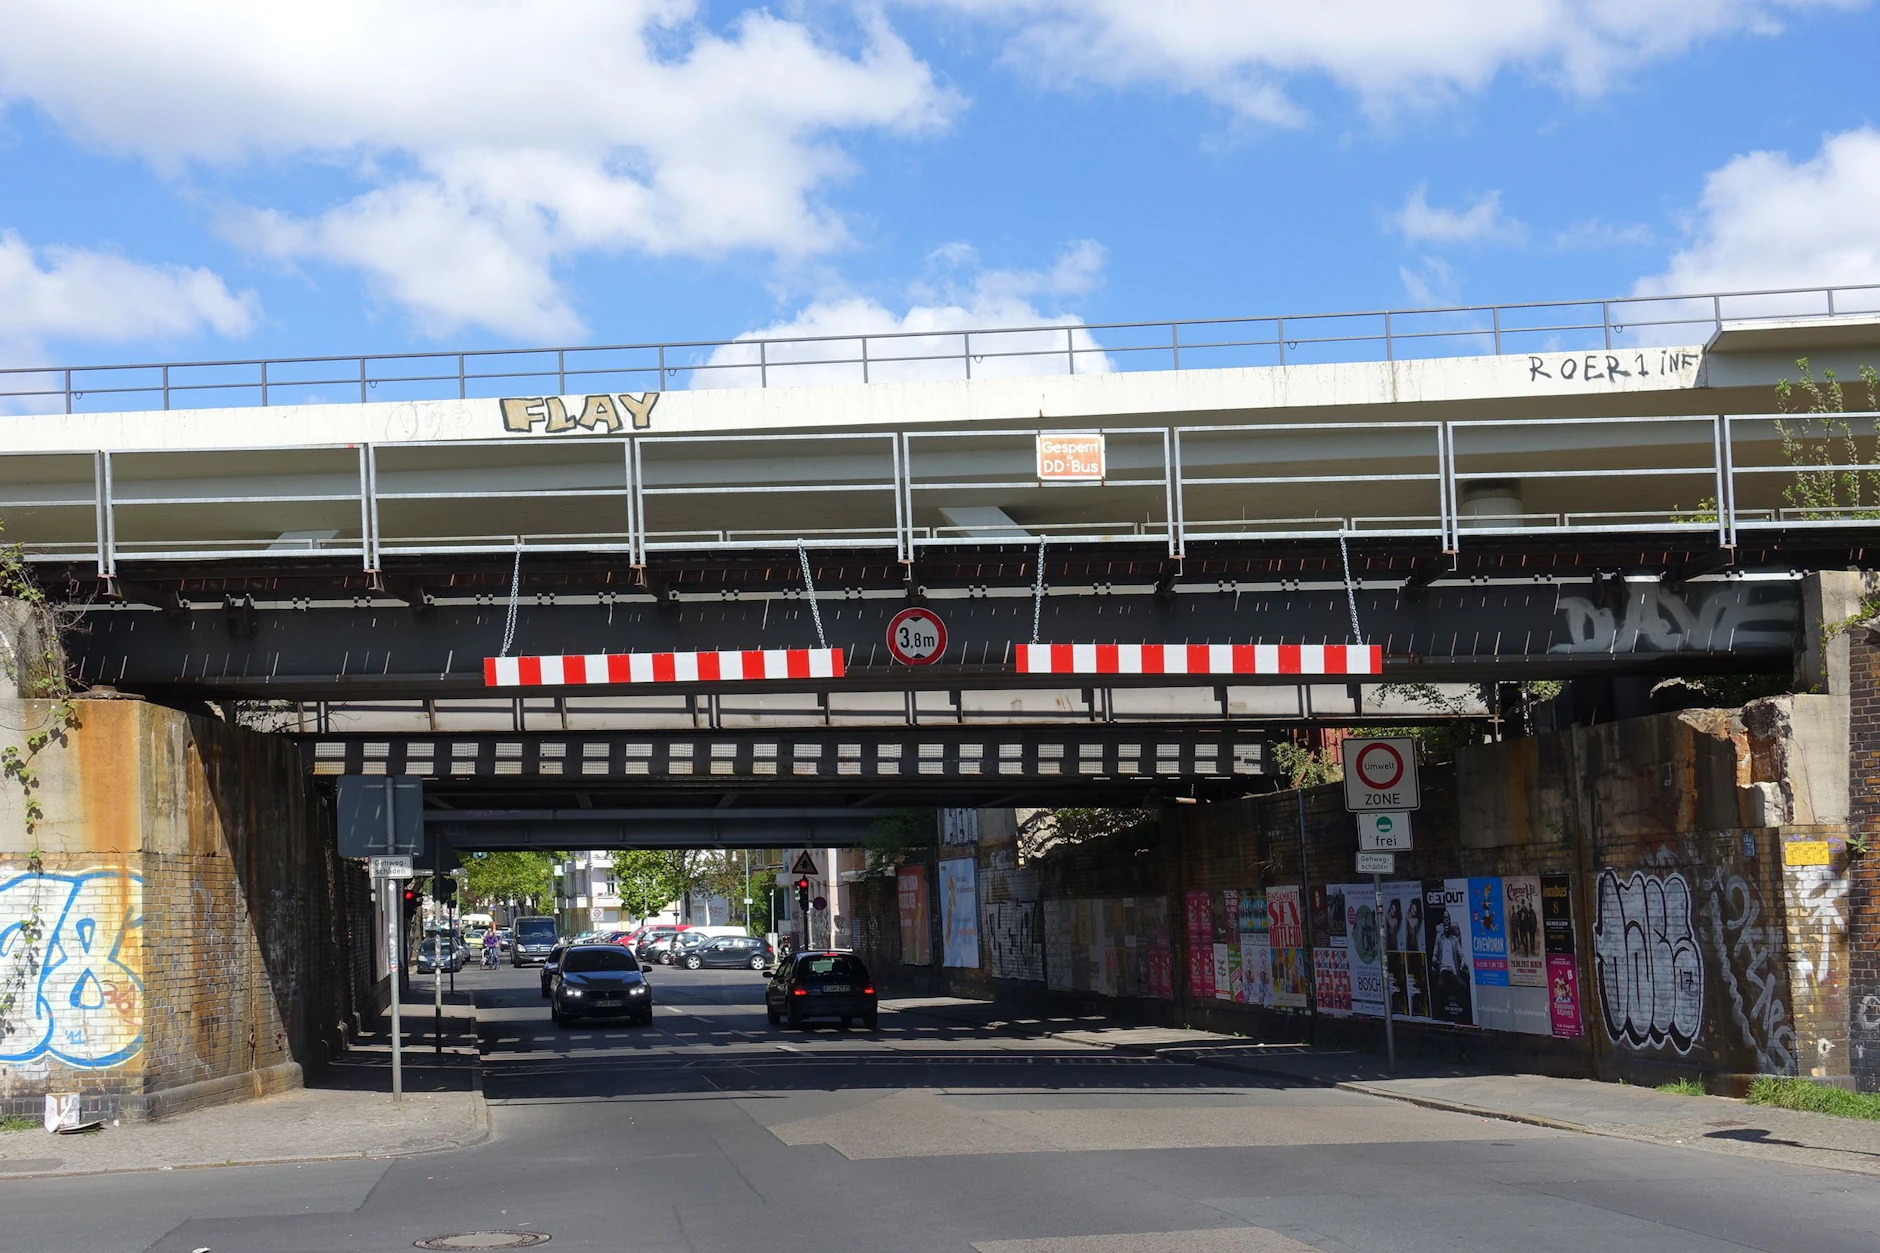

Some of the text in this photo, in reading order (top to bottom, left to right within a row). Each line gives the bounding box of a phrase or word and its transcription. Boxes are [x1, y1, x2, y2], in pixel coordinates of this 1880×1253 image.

[499, 392, 660, 434] FLAY
[1043, 459, 1099, 473] DD-Bus
[1364, 761, 1395, 771] Umwelt
[1365, 793, 1401, 806] ZONE
[1375, 834, 1397, 847] frei
[374, 859, 407, 868] Gehweg-
[1360, 855, 1390, 864] Gehweg-
[1361, 862, 1389, 870] schäden
[375, 866, 406, 875] schäden
[1426, 891, 1464, 904] GET OUT
[1268, 900, 1301, 926] SEX
[1357, 976, 1381, 992] BOSCH
